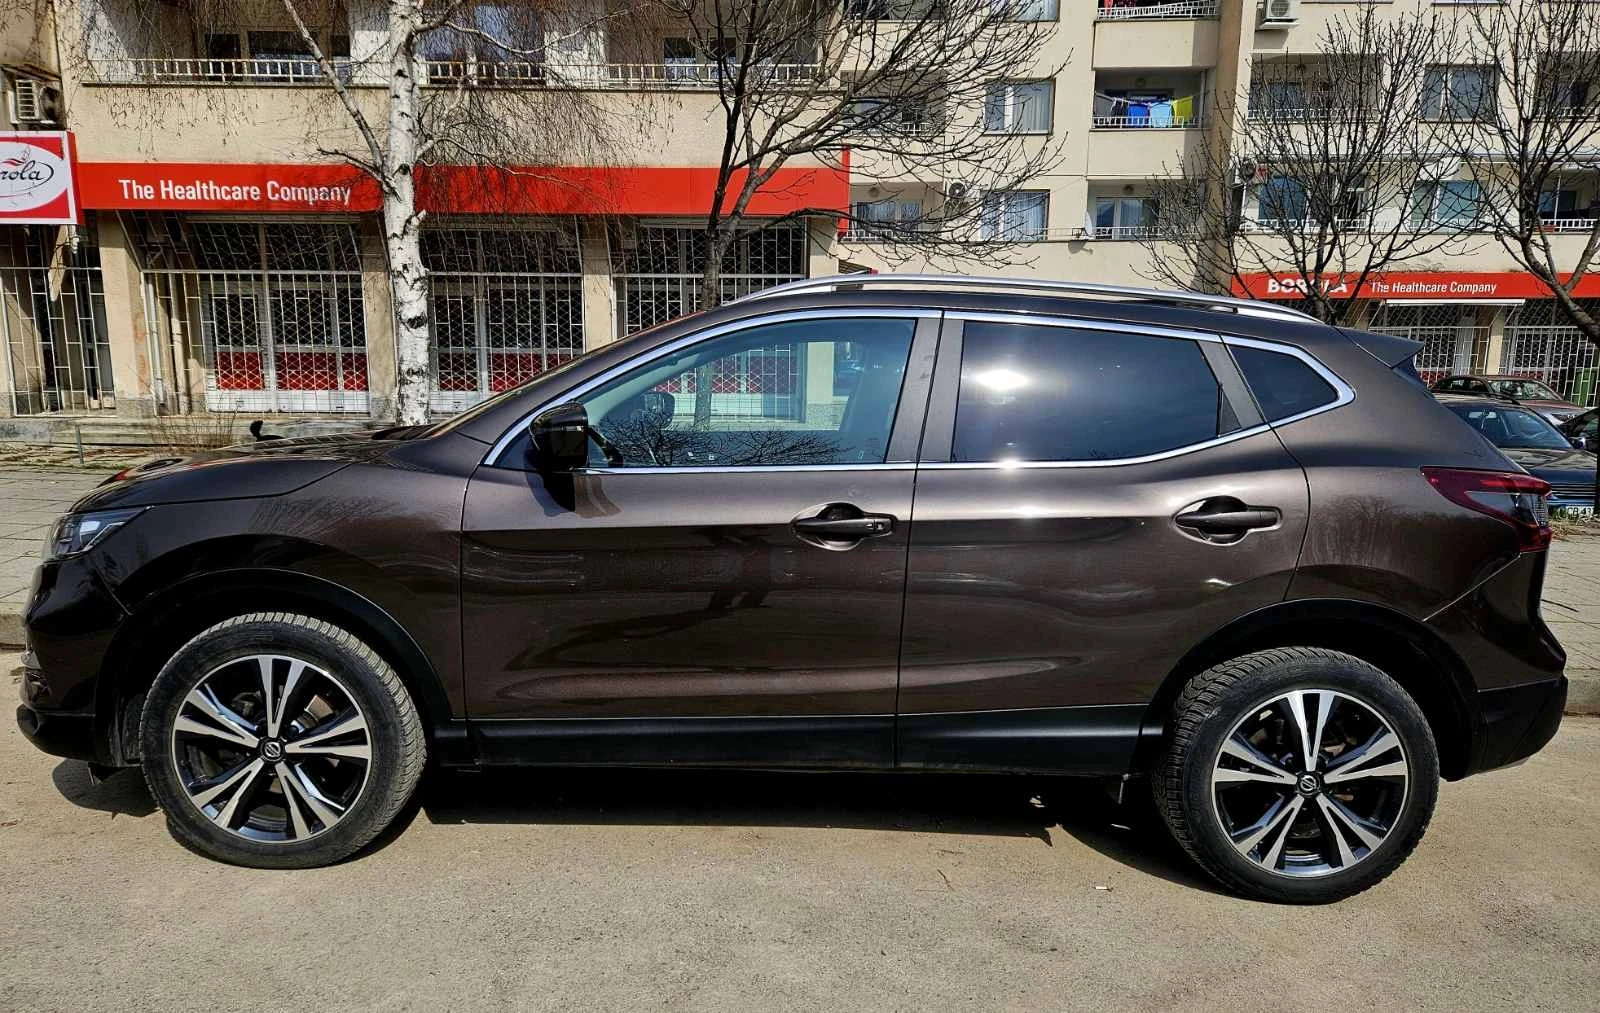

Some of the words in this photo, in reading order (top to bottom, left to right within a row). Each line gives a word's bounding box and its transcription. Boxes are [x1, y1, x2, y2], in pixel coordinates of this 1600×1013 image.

[118, 179, 155, 200] The
[160, 179, 261, 201] Healthcare
[266, 180, 351, 206] Company
[1371, 282, 1390, 293] The
[1392, 282, 1448, 293] Healthcare
[1450, 281, 1498, 295] Company
